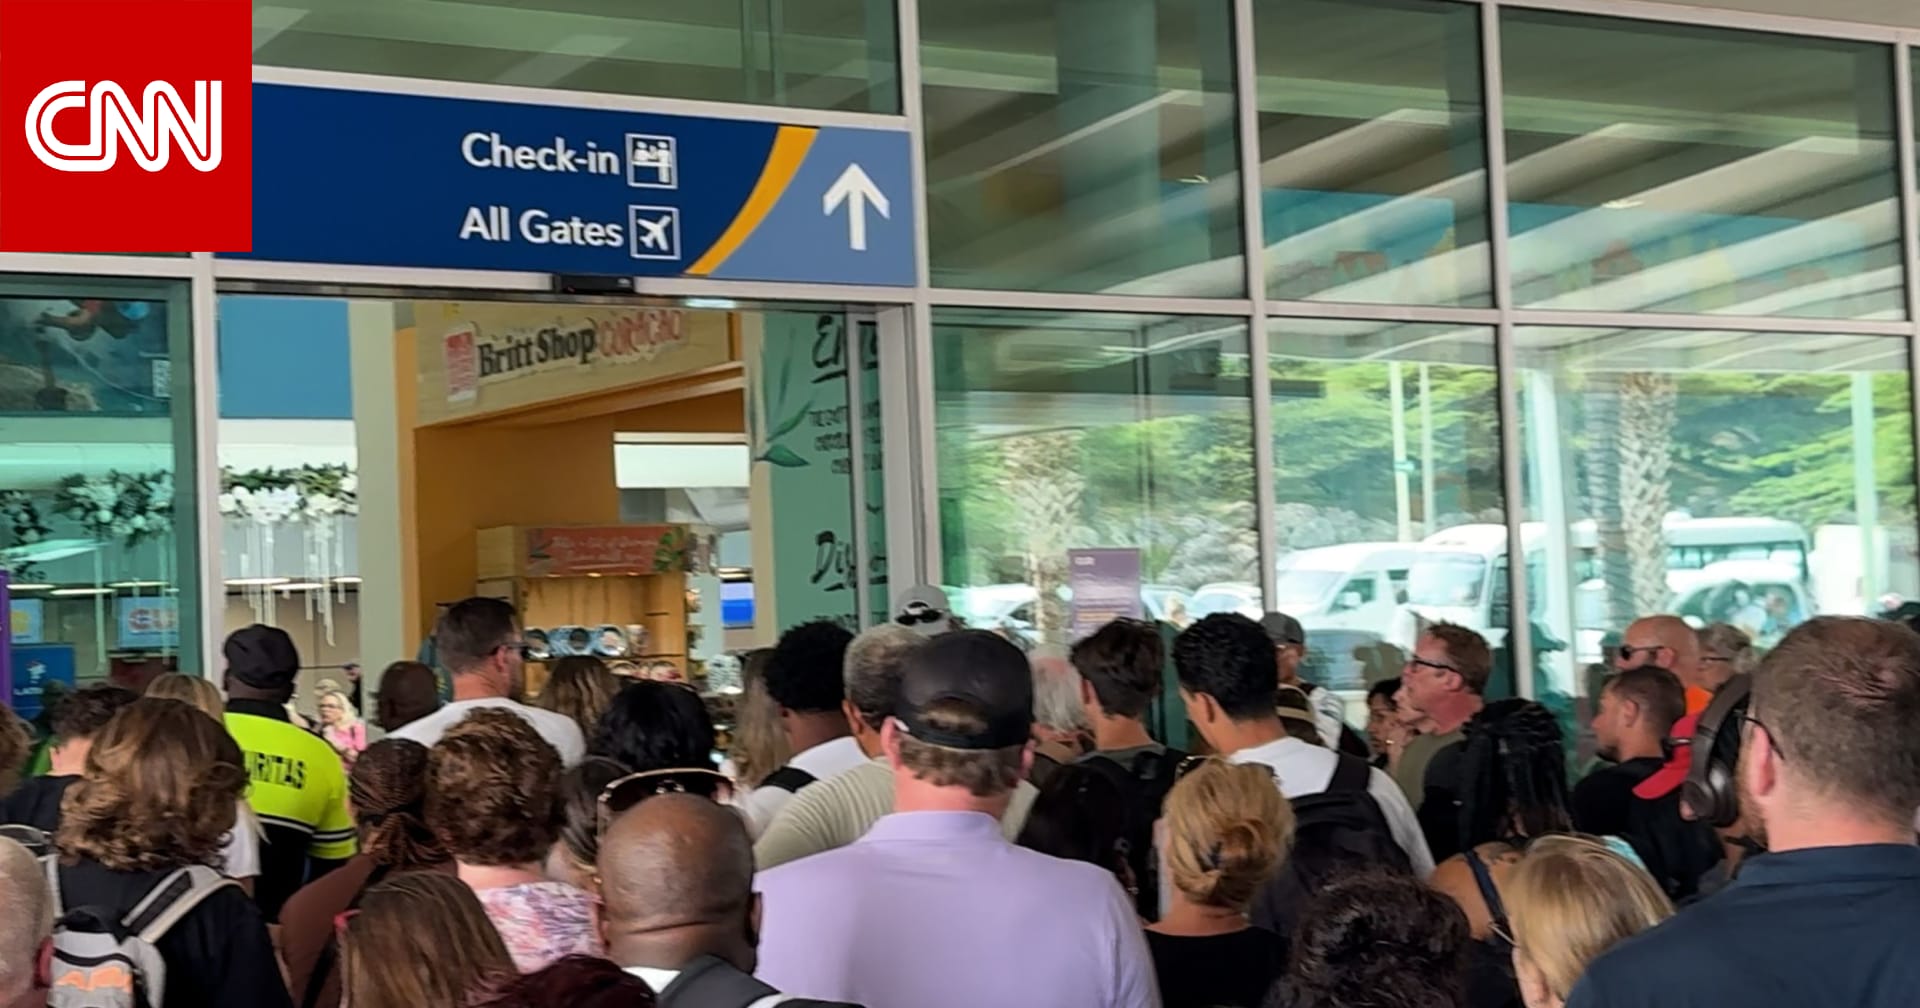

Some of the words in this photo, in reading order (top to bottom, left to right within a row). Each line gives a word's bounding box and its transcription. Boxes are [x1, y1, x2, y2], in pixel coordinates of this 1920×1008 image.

[461, 132, 620, 175] Check-in
[459, 205, 510, 241] All
[519, 209, 624, 247] Gates
[477, 335, 534, 378] Britt
[536, 328, 596, 364] Shop
